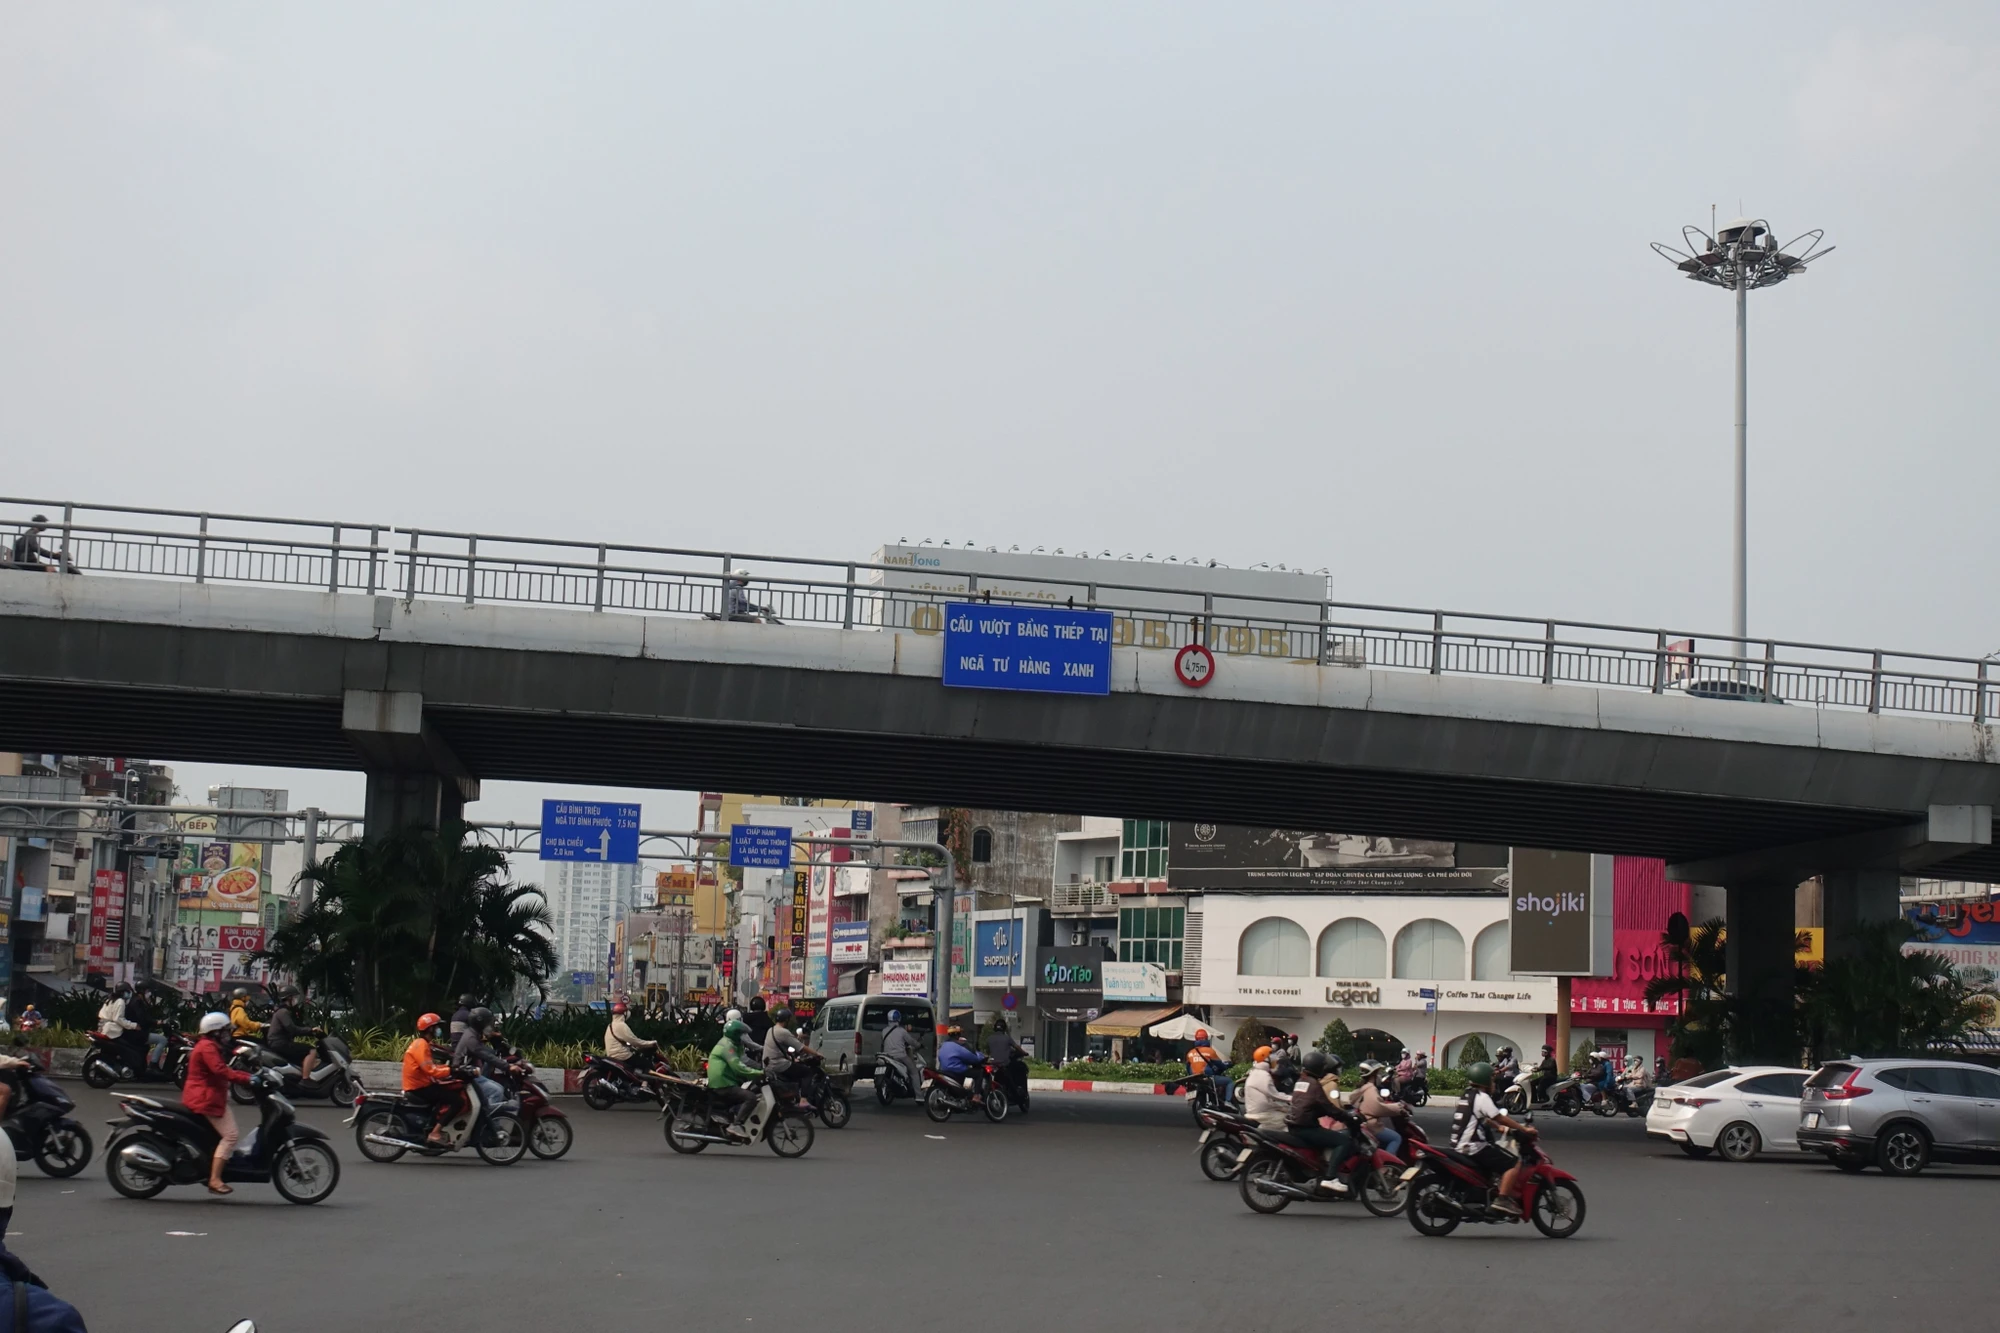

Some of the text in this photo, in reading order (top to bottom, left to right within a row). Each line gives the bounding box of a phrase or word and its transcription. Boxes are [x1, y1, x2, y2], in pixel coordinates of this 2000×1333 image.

[950, 614, 1108, 644] CẦU VƯỢT BẰNG THÉP TẠI
[960, 654, 1094, 678] NGÃ TƯ HÀNG XANH
[556, 803, 567, 814] CẦU
[569, 804, 582, 814] BÌNH
[584, 805, 600, 816] TRIỆU
[555, 816, 567, 825] NGÃ
[568, 816, 577, 825] TƯ
[578, 816, 592, 826] BÌNH
[1516, 892, 1585, 916] shojiki
[1059, 965, 1092, 984] Dr.Táo
[1326, 986, 1380, 1006] Legend
[1517, 992, 1532, 1000] Life
